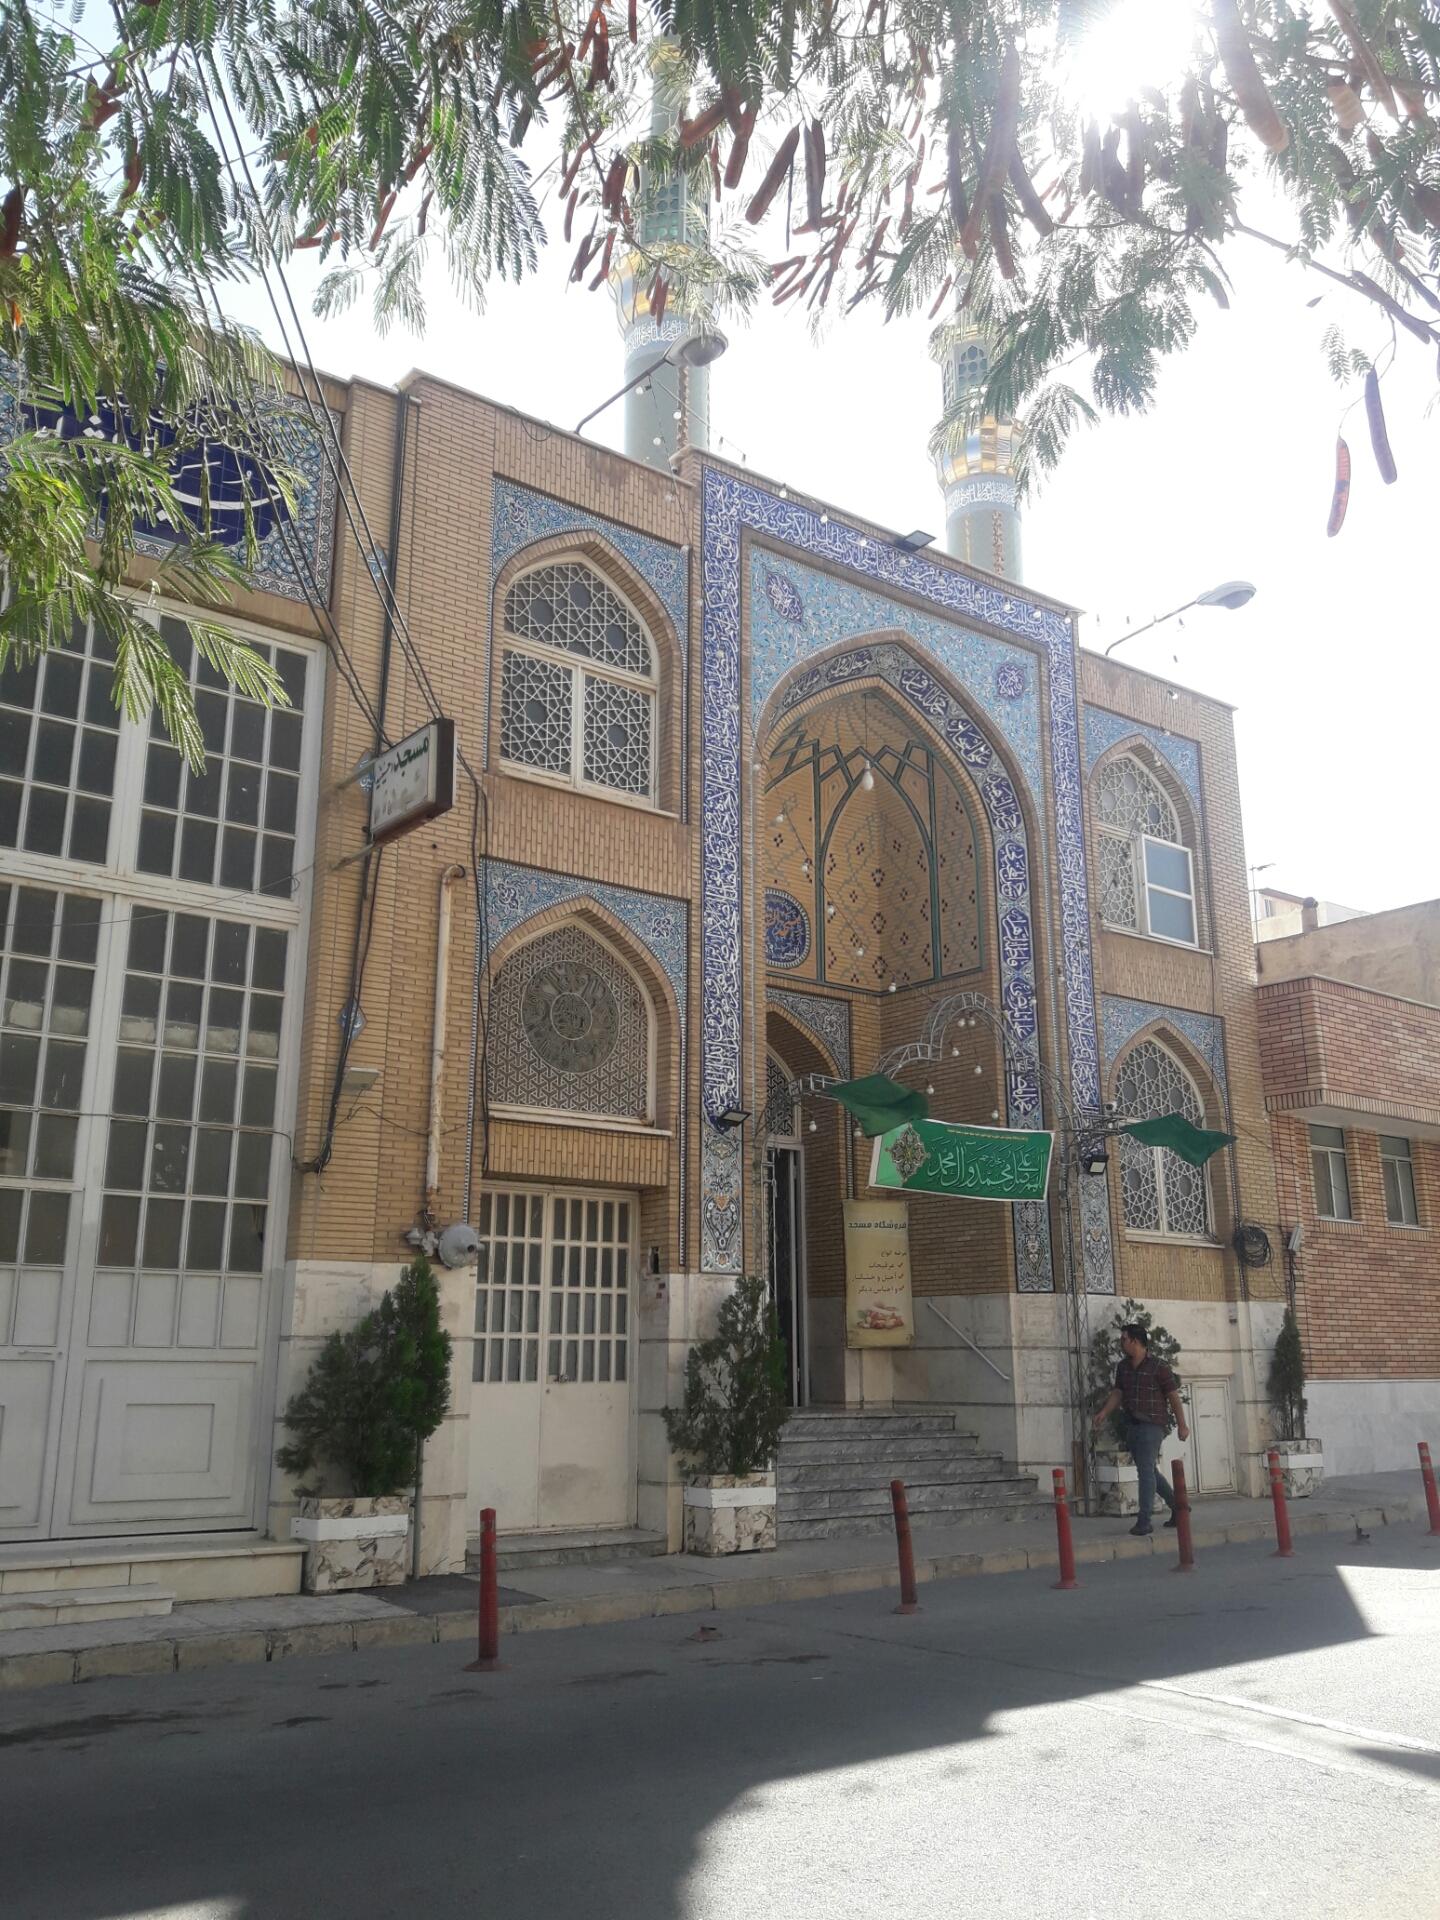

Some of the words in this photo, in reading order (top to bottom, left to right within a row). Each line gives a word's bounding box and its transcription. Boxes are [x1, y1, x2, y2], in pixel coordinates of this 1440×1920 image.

[394, 737, 429, 777] مسجد
[848, 1222, 872, 1230] مسجد
[874, 1221, 907, 1230] فروشگاه
